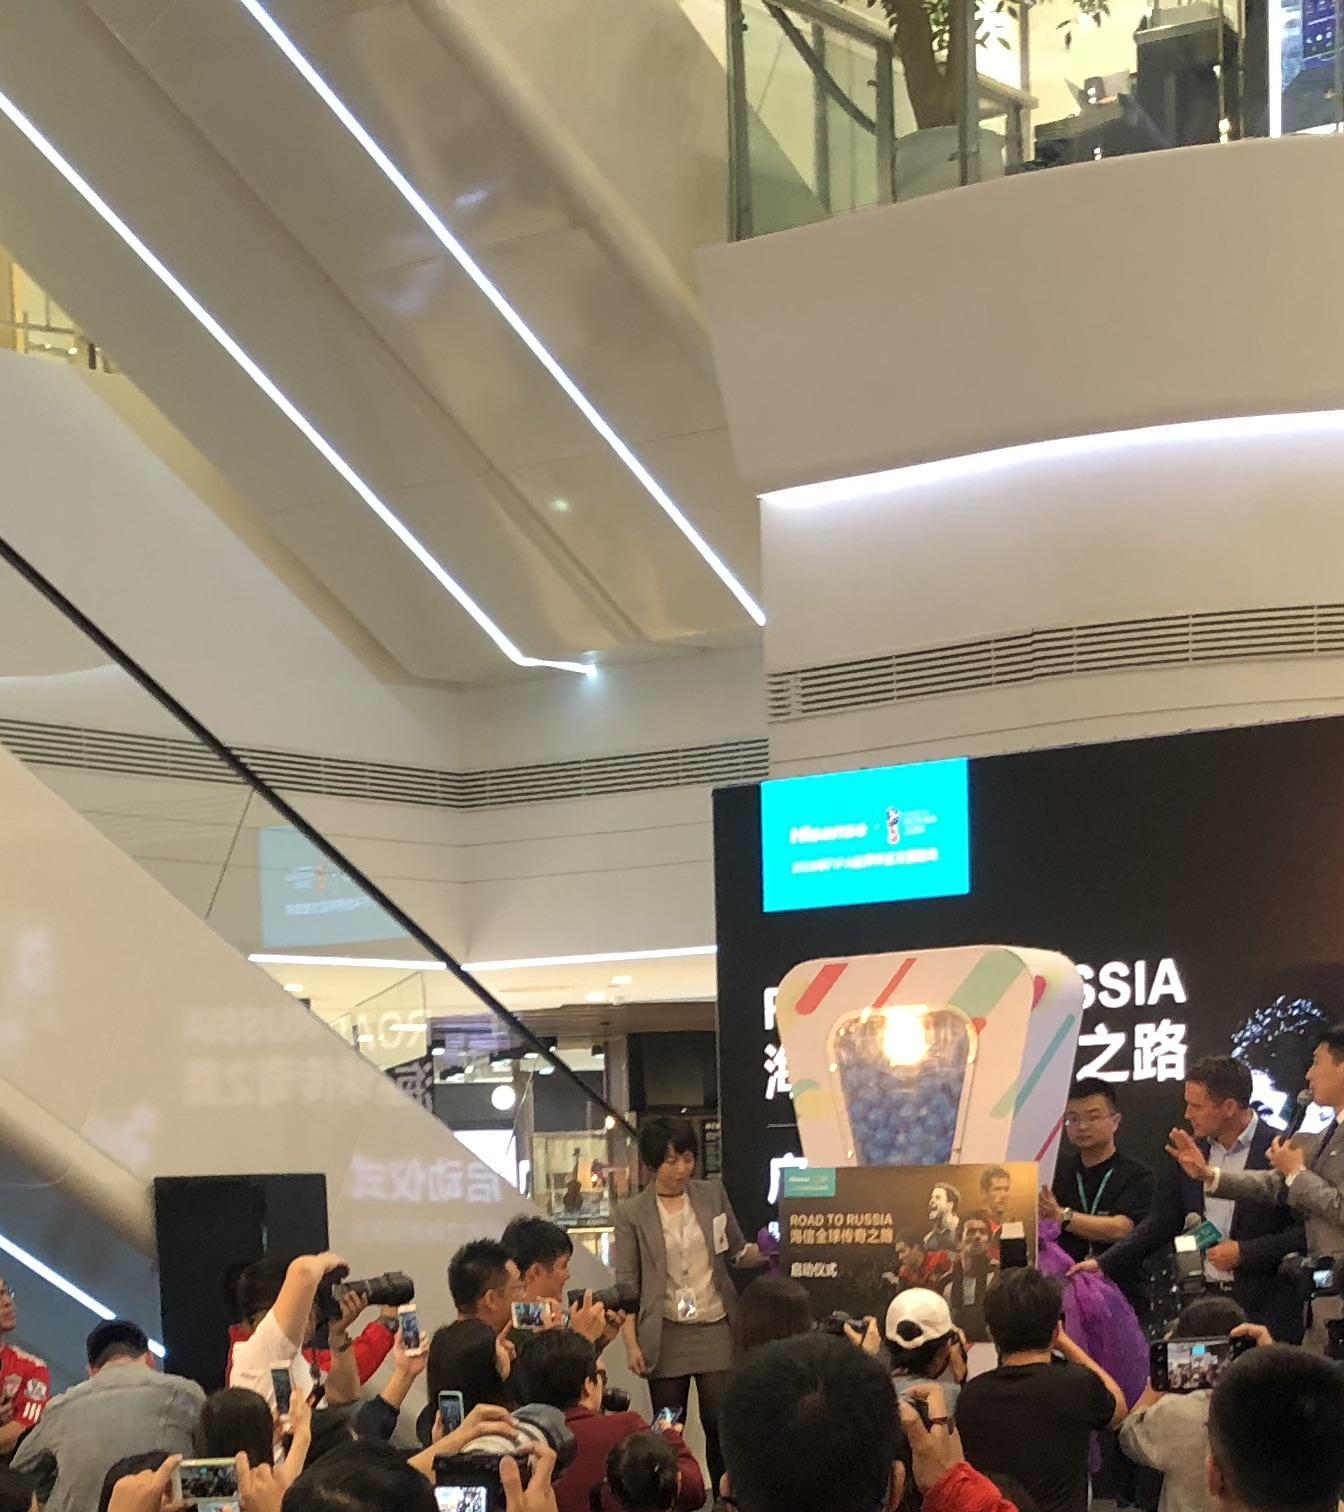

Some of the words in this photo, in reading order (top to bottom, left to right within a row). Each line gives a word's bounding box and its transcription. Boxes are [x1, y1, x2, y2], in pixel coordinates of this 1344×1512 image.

[790, 1214, 824, 1227] ROAD
[827, 1213, 844, 1226] TO
[846, 1212, 894, 1226] RUSSIA
